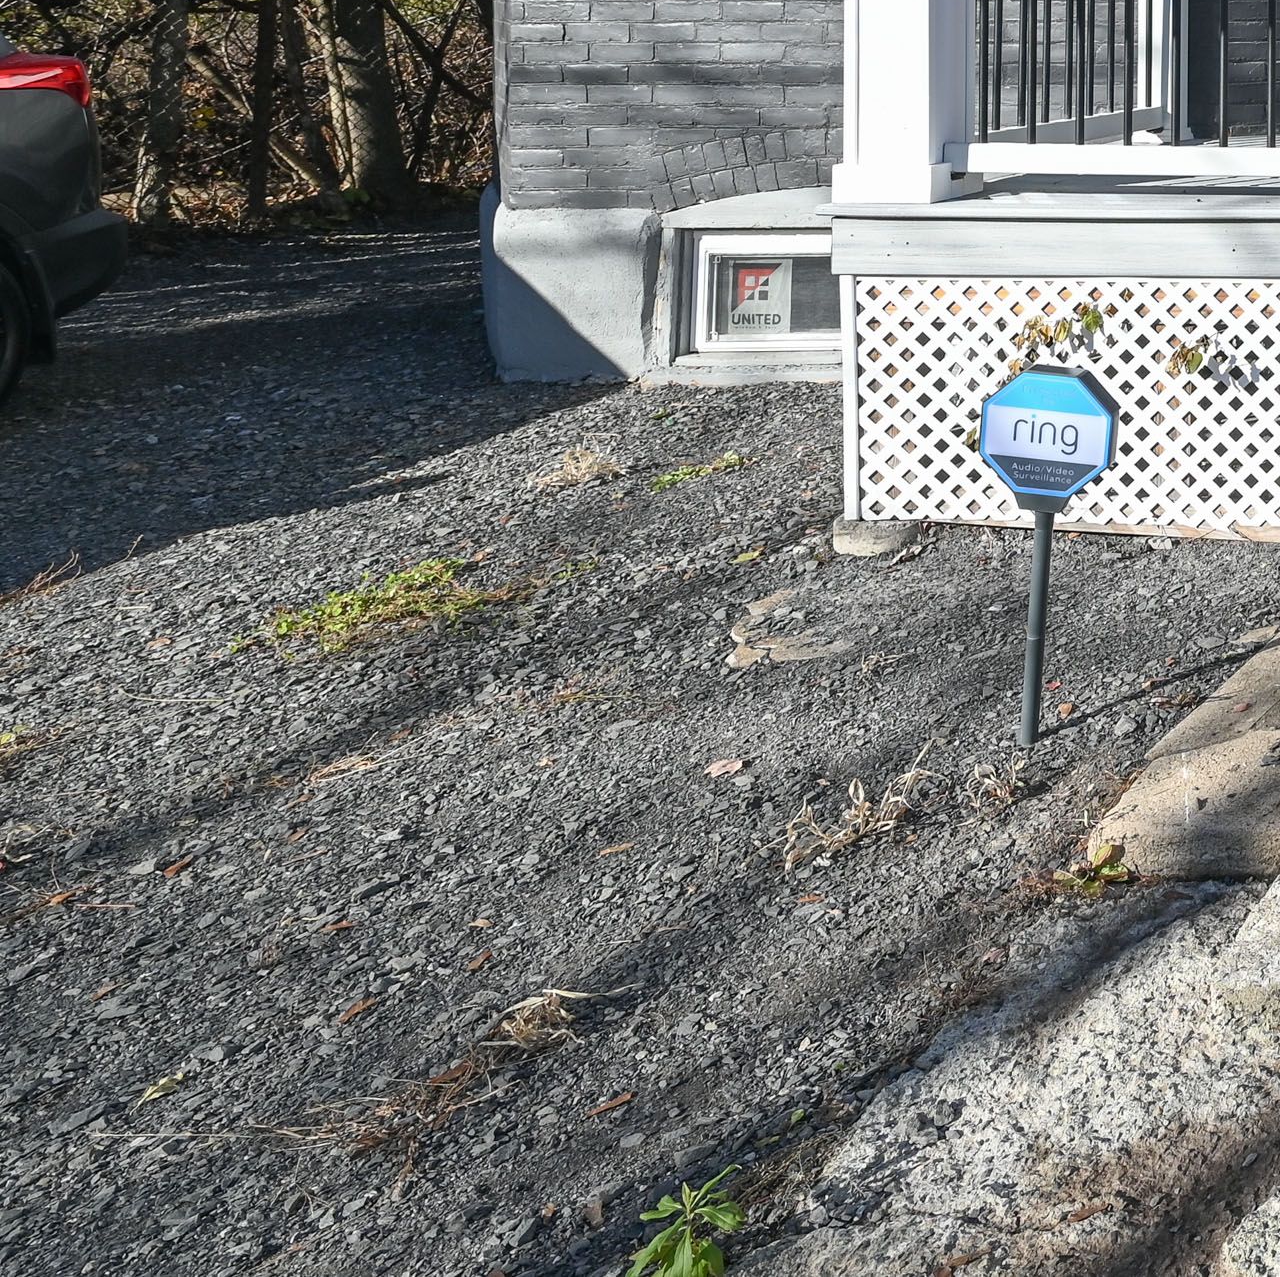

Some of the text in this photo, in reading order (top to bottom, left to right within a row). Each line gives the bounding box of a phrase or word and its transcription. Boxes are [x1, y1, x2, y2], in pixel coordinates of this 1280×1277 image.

[731, 313, 782, 325] UNITED
[1012, 413, 1079, 456] ring
[1011, 462, 1075, 476] Audio/Video
[1012, 471, 1072, 484] Surveillance
